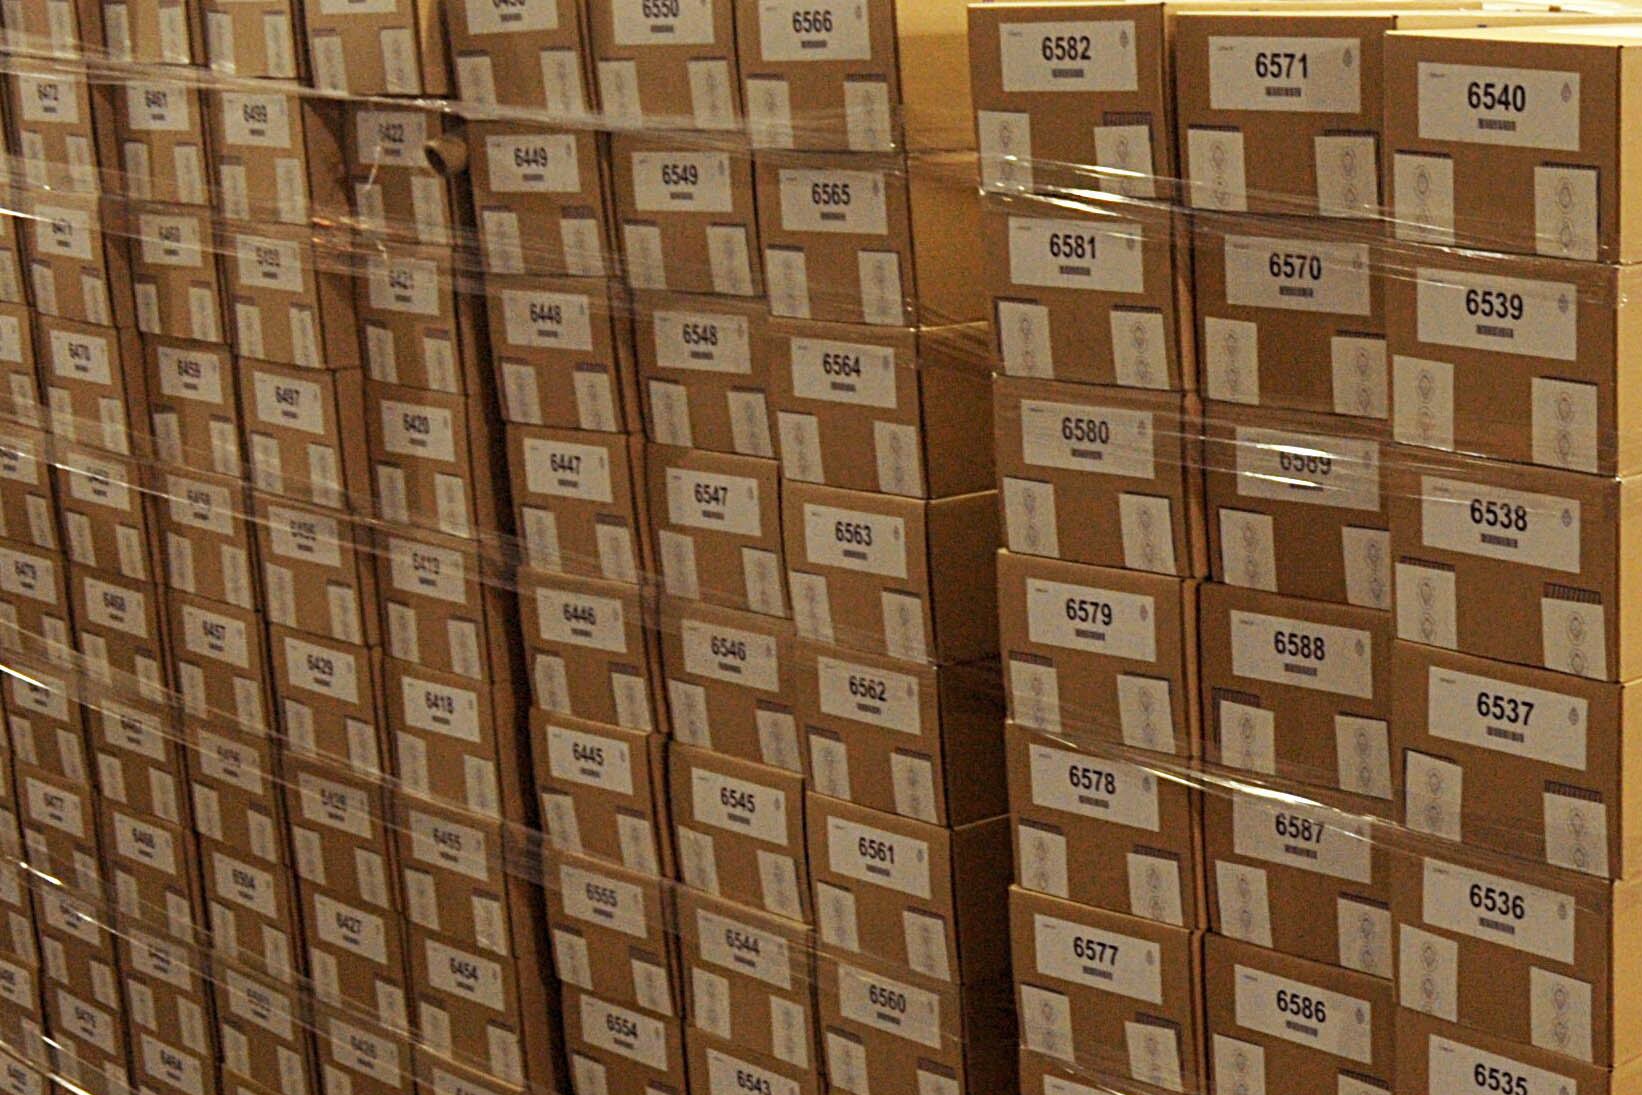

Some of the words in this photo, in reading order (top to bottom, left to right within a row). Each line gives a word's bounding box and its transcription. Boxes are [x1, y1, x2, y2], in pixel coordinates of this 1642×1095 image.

[642, 0, 679, 18] 6550
[793, 11, 832, 33] 6566
[1042, 36, 1091, 61] 6582
[1255, 52, 1308, 80] 6571
[1467, 82, 1526, 113] 6540
[514, 149, 547, 168] 6449
[662, 165, 697, 185] 6549
[812, 183, 850, 206] 6565
[1049, 233, 1097, 260] 6581
[1269, 253, 1322, 282] 6570
[1466, 290, 1524, 321] 6539
[683, 325, 718, 347] 6548
[823, 353, 860, 377] 6564
[1062, 417, 1110, 446] 6580
[550, 453, 581, 476] 6447
[694, 483, 727, 506] 6547
[1469, 498, 1528, 533] 6538
[835, 521, 873, 546] 6563
[1065, 599, 1113, 627] 6579
[711, 637, 746, 661] 6546
[1274, 630, 1325, 662] 6588
[849, 675, 887, 701] 6562
[1477, 691, 1534, 728] 6537
[572, 742, 604, 766] 6445
[1069, 766, 1116, 796] 6578
[721, 788, 755, 813] 6545
[1275, 813, 1325, 844] 6587
[858, 837, 895, 864] 6561
[1469, 883, 1525, 922] 6536
[725, 928, 760, 956] 6544
[1072, 936, 1119, 967] 6577
[869, 984, 906, 1013] 6560
[1276, 989, 1327, 1024] 6586
[606, 1014, 638, 1039] 6554
